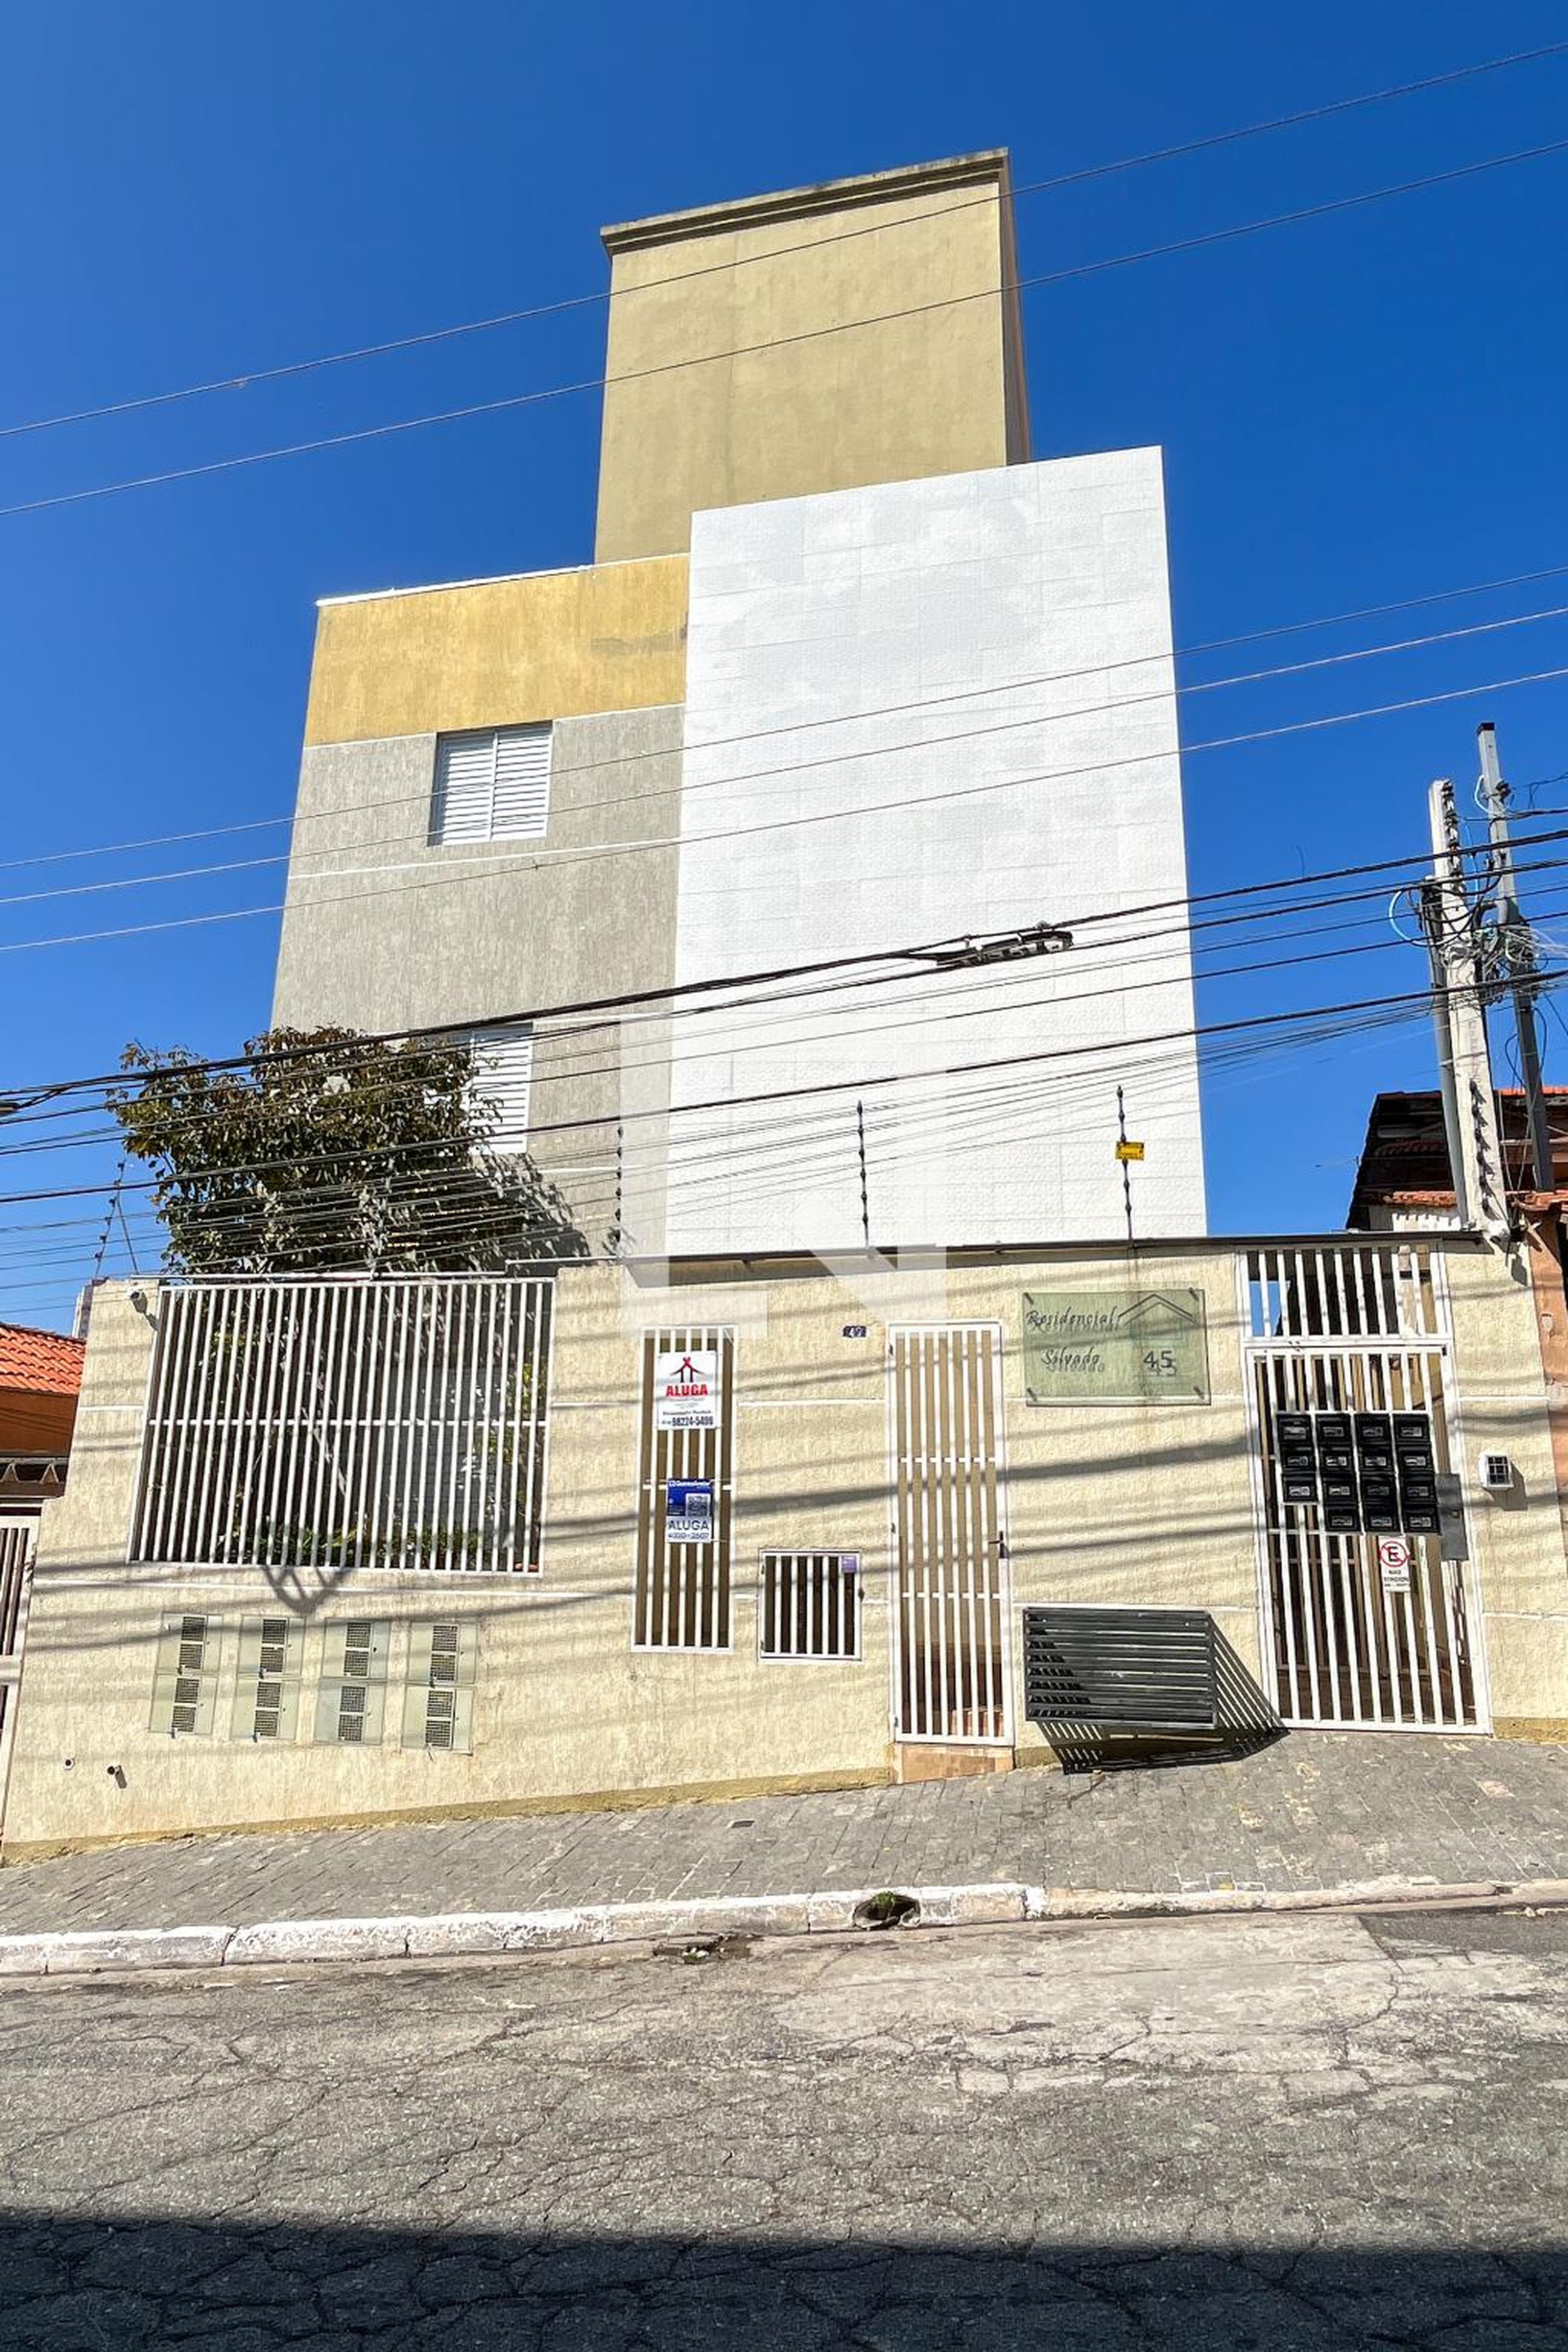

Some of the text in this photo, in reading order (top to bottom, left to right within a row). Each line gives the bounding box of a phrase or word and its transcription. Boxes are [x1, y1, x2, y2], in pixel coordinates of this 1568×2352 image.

[1026, 1306, 1117, 1329] Residencial
[1143, 1350, 1172, 1368] 45
[666, 1384, 708, 1397] ALUGA
[668, 1520, 710, 1530] ALUGA
